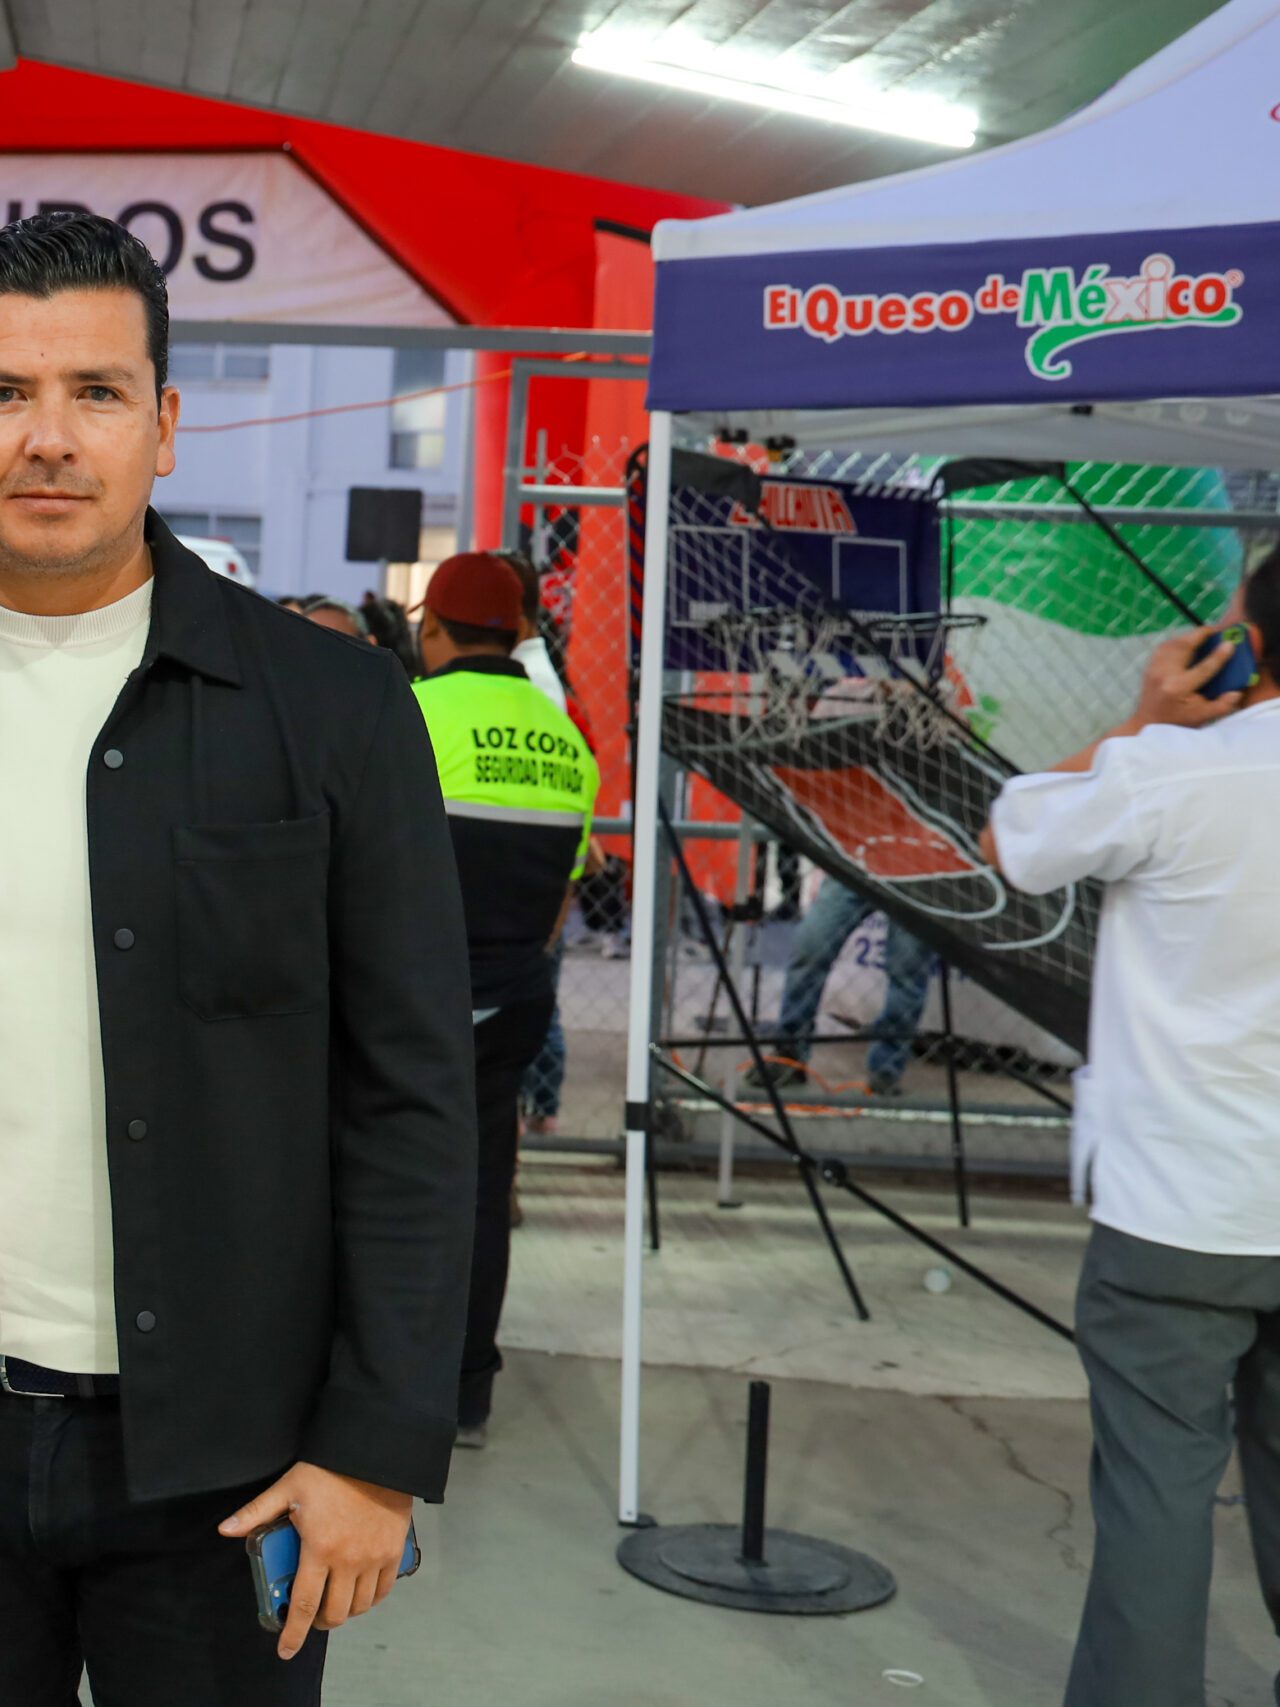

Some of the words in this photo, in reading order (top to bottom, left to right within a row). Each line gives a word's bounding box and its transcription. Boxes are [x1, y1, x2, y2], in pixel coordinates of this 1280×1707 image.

[769, 288, 798, 325] El
[806, 288, 970, 337] Queso
[980, 278, 1020, 310] de
[1022, 256, 1228, 324] México
[472, 726, 518, 750] LOZ
